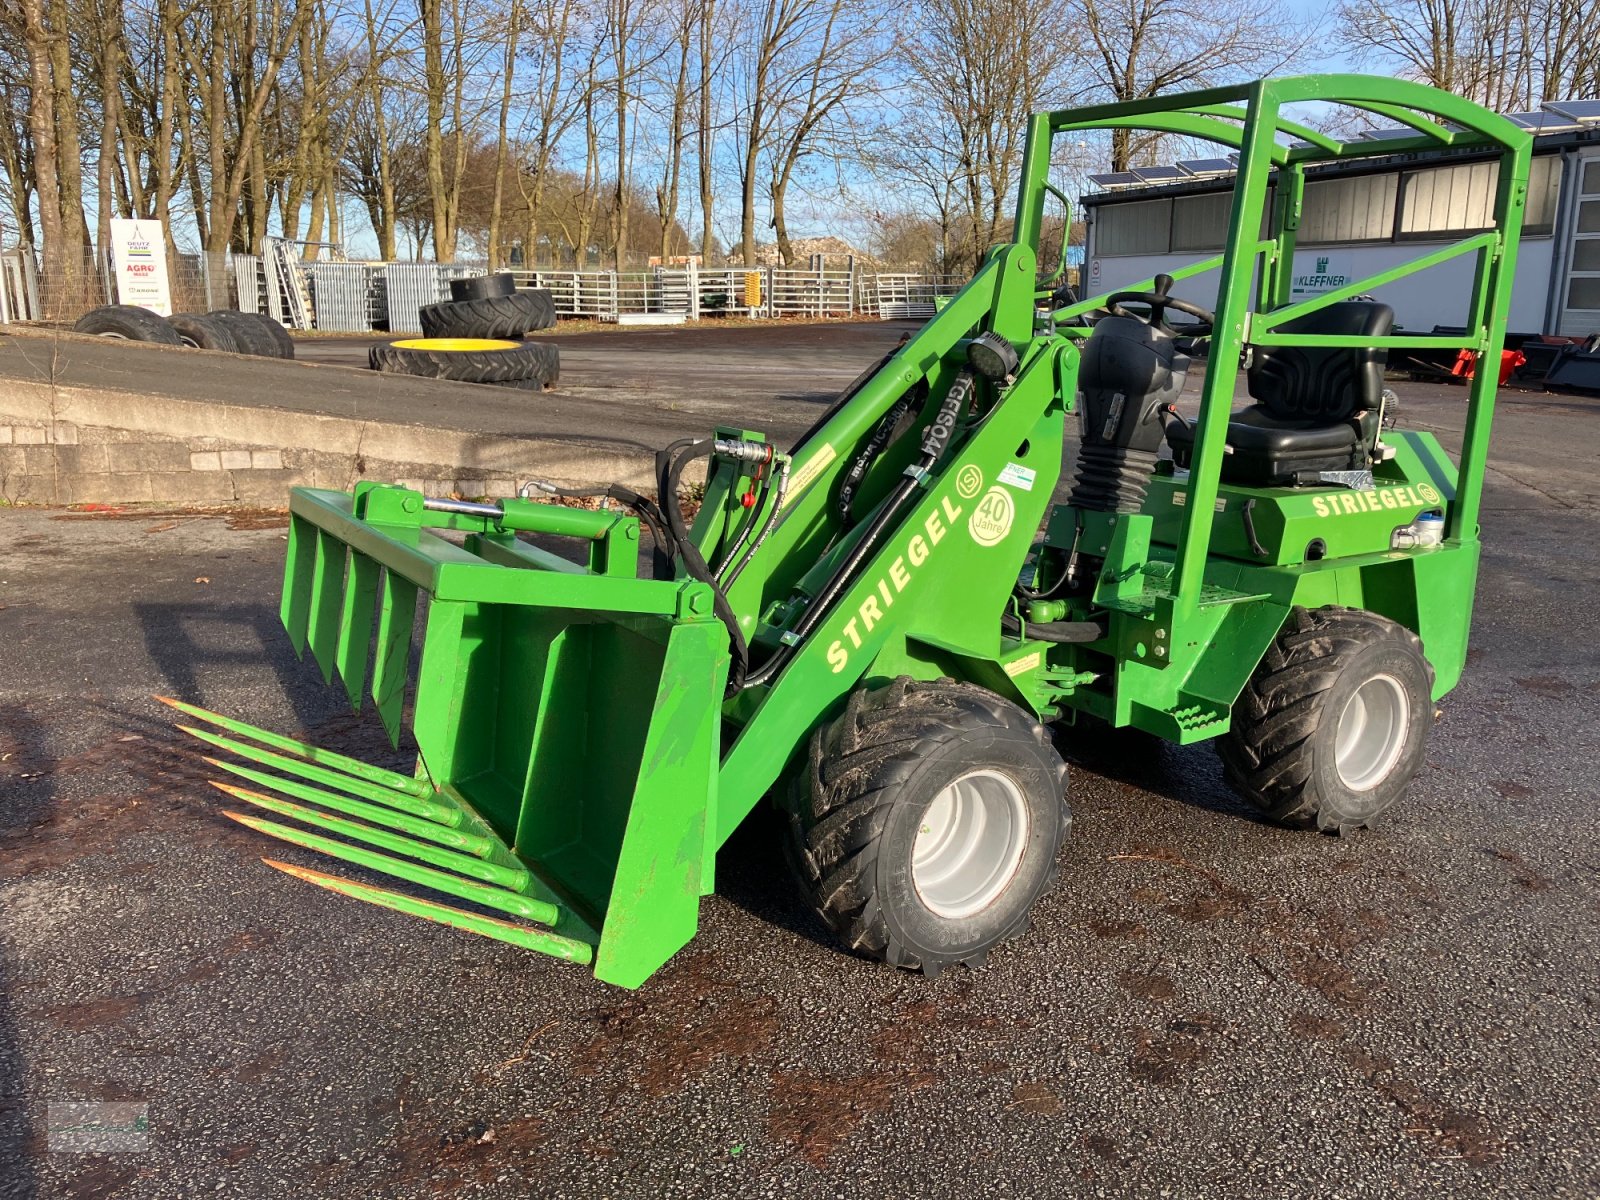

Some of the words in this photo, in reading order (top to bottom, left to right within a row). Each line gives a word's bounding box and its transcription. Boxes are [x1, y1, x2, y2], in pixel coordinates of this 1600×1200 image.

[127, 264, 155, 272] AGRO
[1298, 275, 1345, 287] KLEFFNER
[979, 495, 1006, 522] 40
[1312, 487, 1424, 518] STRIEGEL
[975, 517, 1003, 534] Jahre
[826, 495, 962, 674] STRIEGEL
